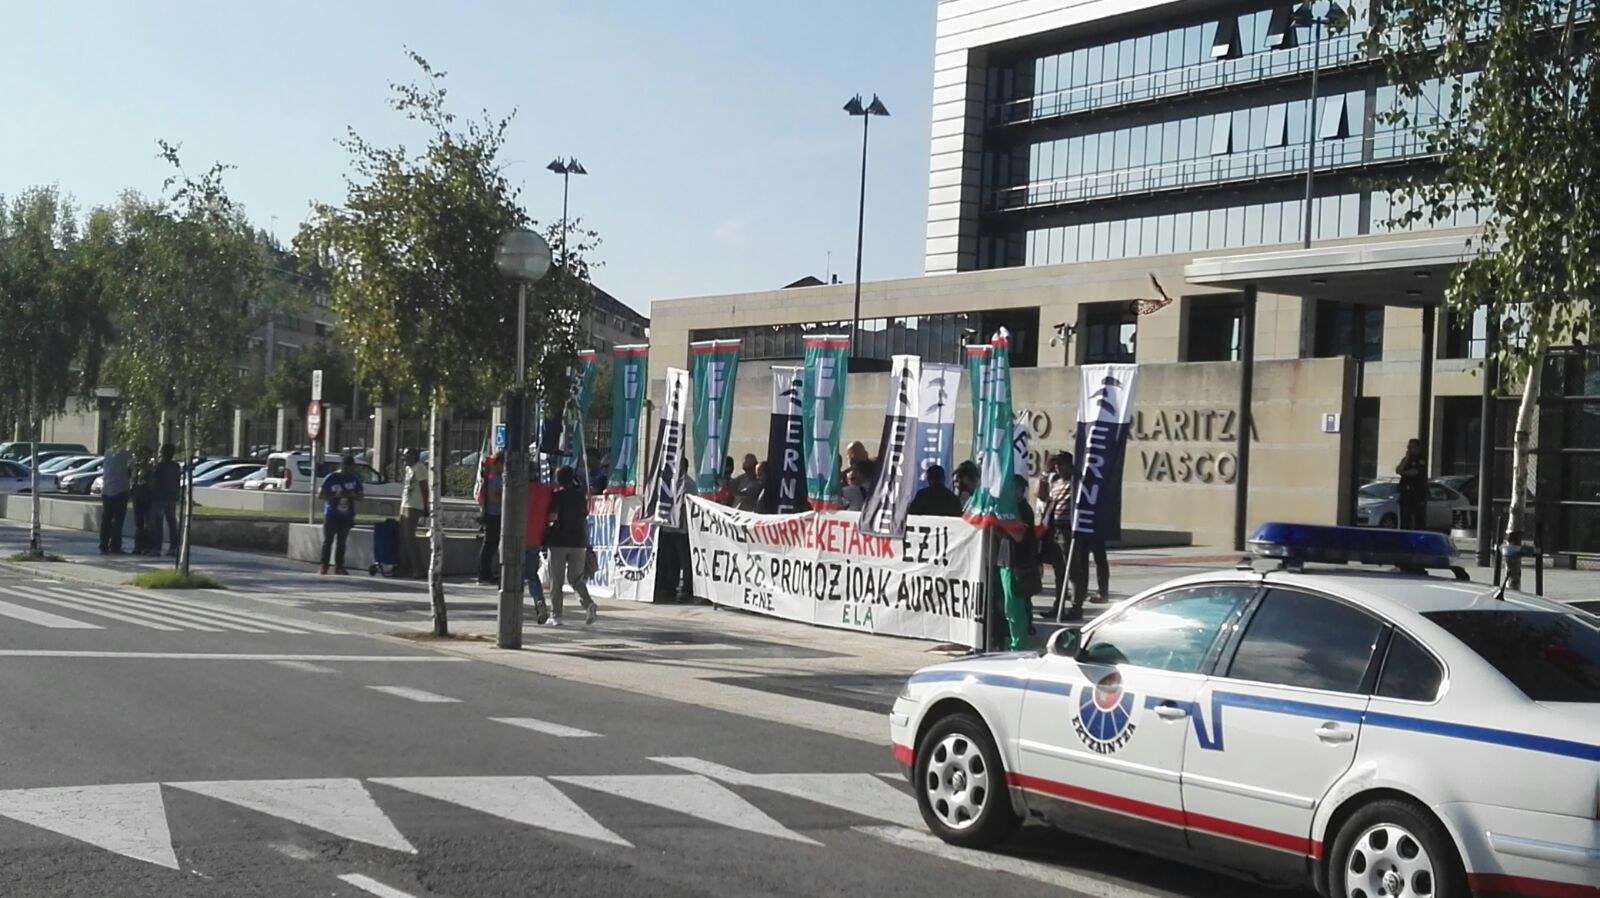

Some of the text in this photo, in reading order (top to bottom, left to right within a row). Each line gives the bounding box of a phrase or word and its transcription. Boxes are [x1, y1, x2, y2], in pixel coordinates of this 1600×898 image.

[805, 357, 837, 476] ELA
[1072, 425, 1109, 534] ERNE
[1141, 451, 1238, 484] VASCO
[712, 549, 742, 585] ETA
[842, 604, 874, 629] ELA
[1071, 714, 1137, 755] ERTZAINTZA
